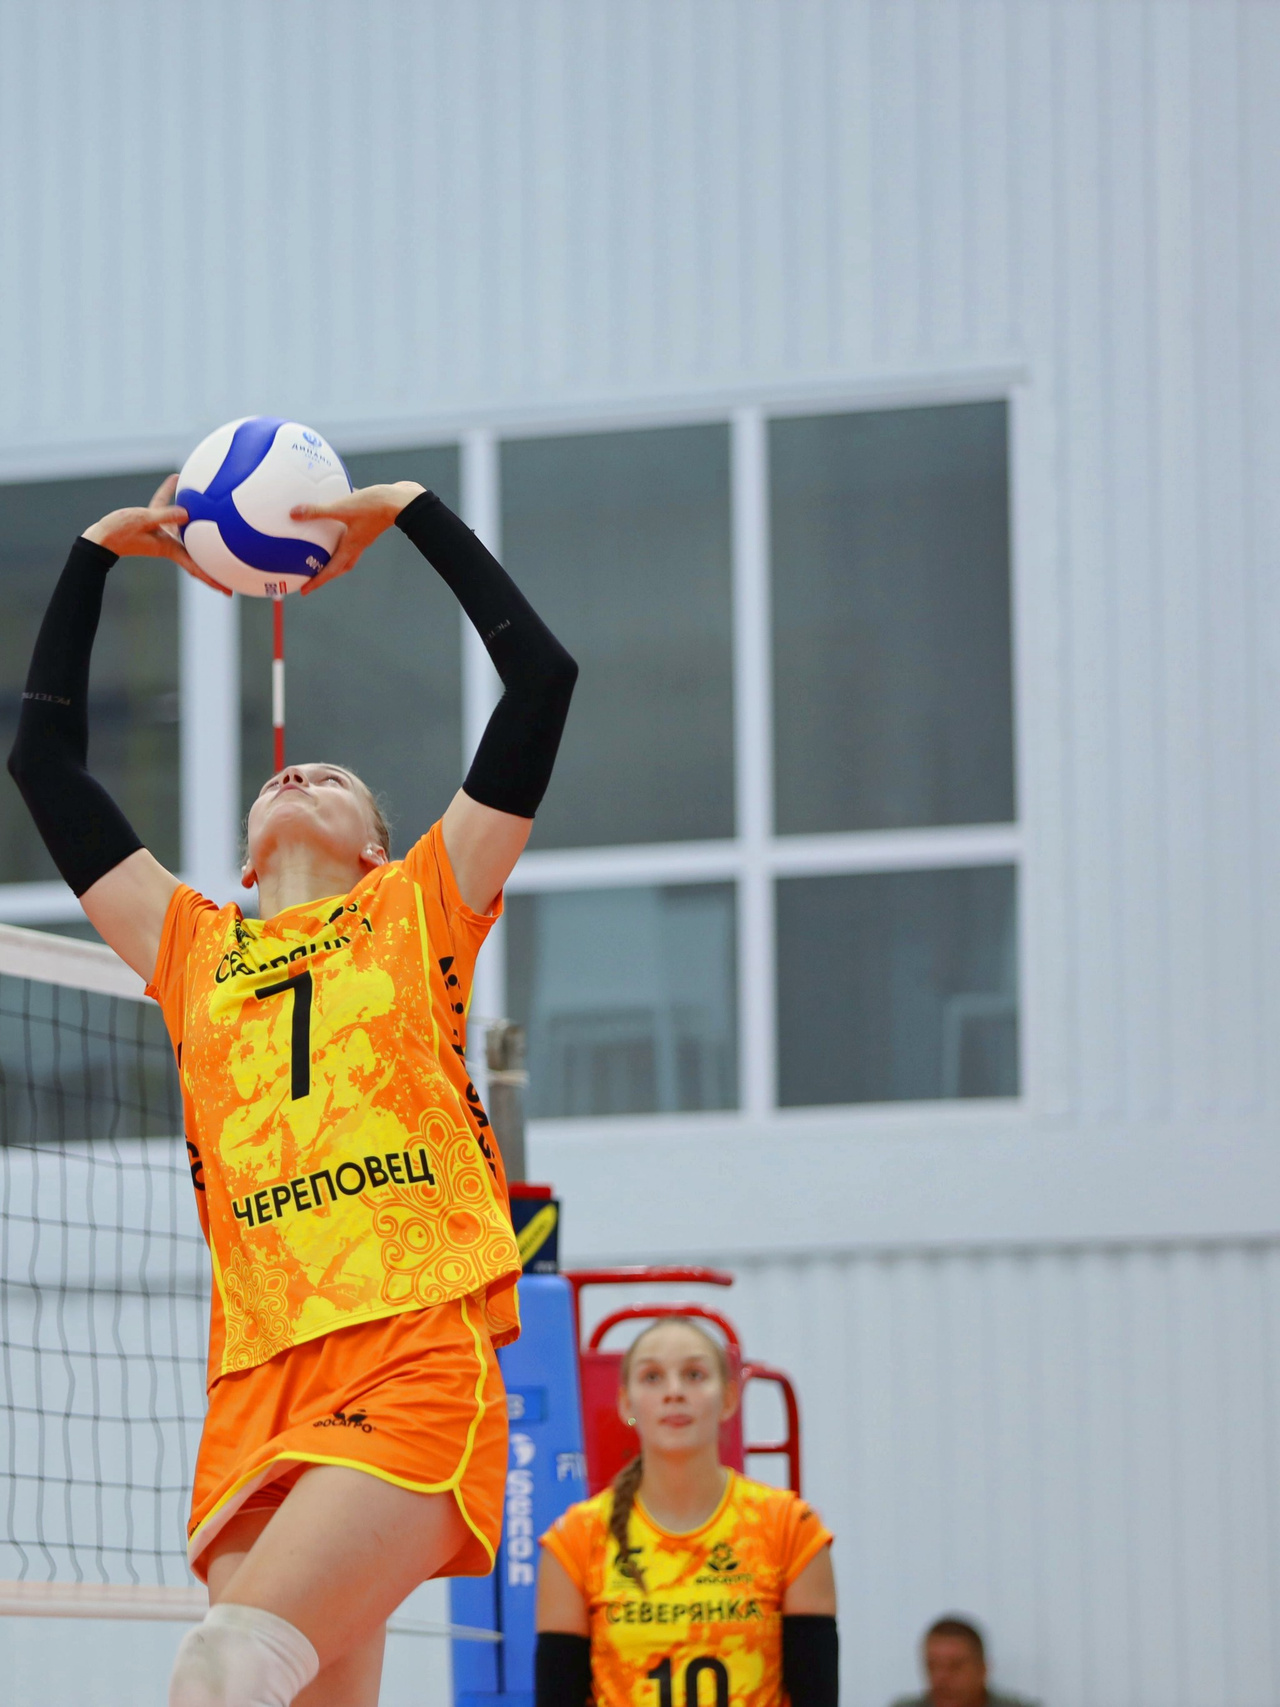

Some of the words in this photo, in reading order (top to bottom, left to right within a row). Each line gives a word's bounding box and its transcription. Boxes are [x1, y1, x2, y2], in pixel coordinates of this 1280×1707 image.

[255, 970, 313, 1102] 7
[232, 1149, 436, 1228] ЧЕРЕПОВЕЦ
[605, 1599, 765, 1624] СЕВЕРЯНКА
[647, 1656, 730, 1707] 10
